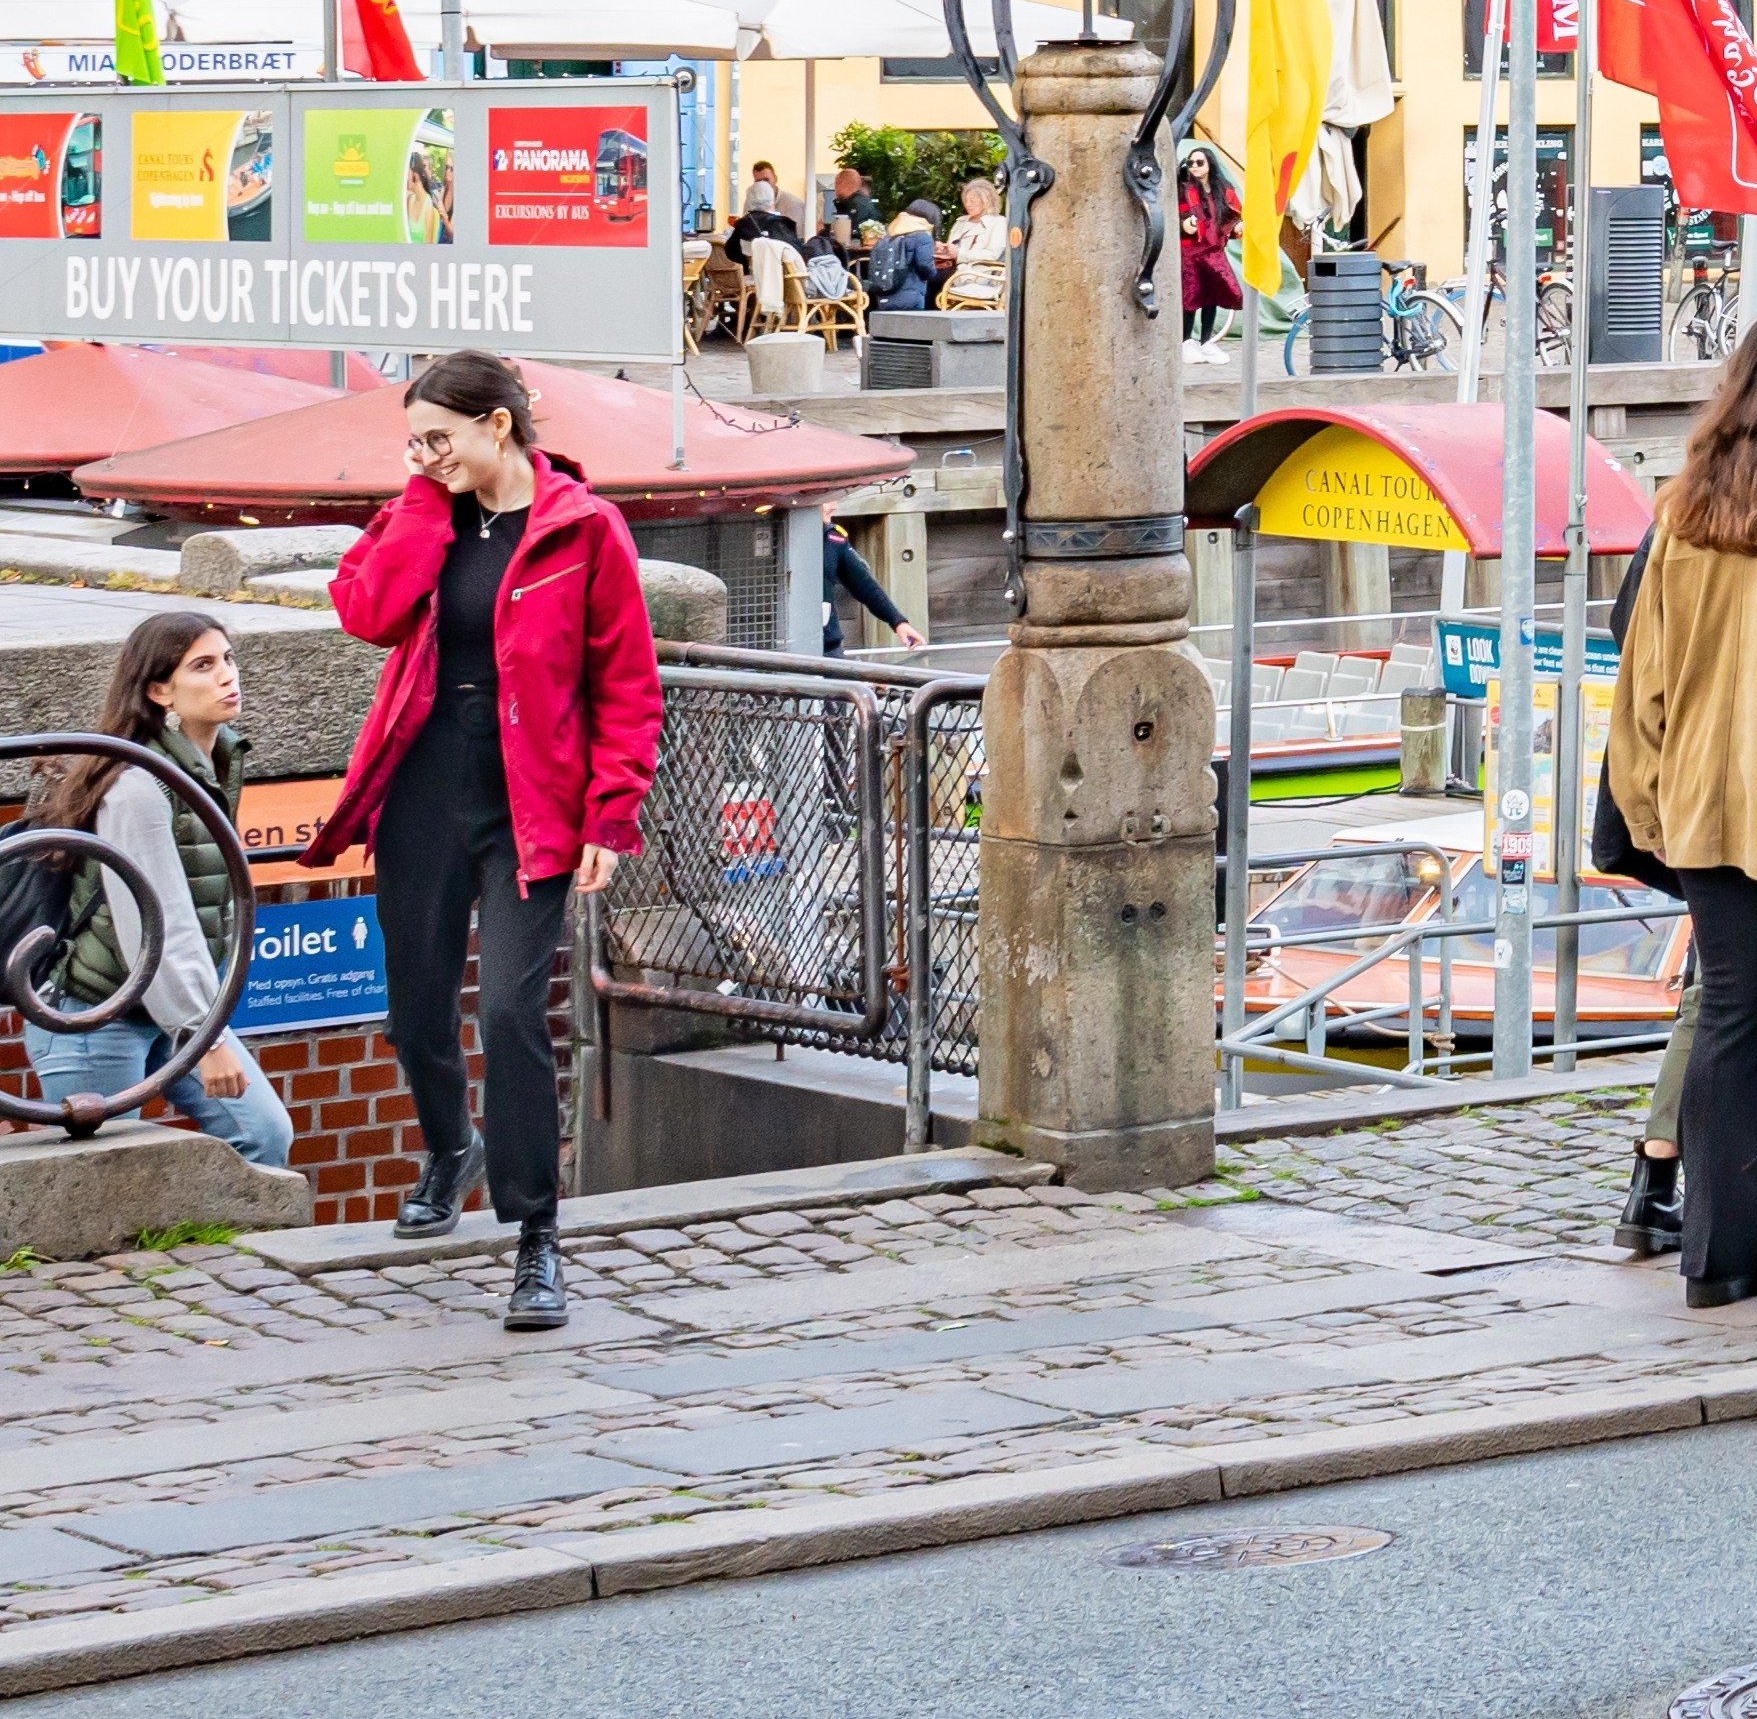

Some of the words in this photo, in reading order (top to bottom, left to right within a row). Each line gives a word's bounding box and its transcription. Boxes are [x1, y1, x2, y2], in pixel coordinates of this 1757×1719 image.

[162, 52, 296, 71] ODERBRÆT
[513, 149, 591, 171] PANORAMA
[495, 204, 555, 219] EXCURSIONS
[557, 205, 570, 220] BY
[571, 206, 590, 220] BUS
[66, 256, 141, 321] BUY
[149, 257, 256, 325] YOUR
[263, 259, 419, 329] TICKETS
[430, 262, 534, 333] HERE
[1306, 468, 1375, 498] CANAL
[1303, 502, 1451, 538] COPENHAGEN
[1466, 637, 1495, 663] LOOK
[245, 825, 284, 847] en
[1502, 835, 1532, 855] 1909
